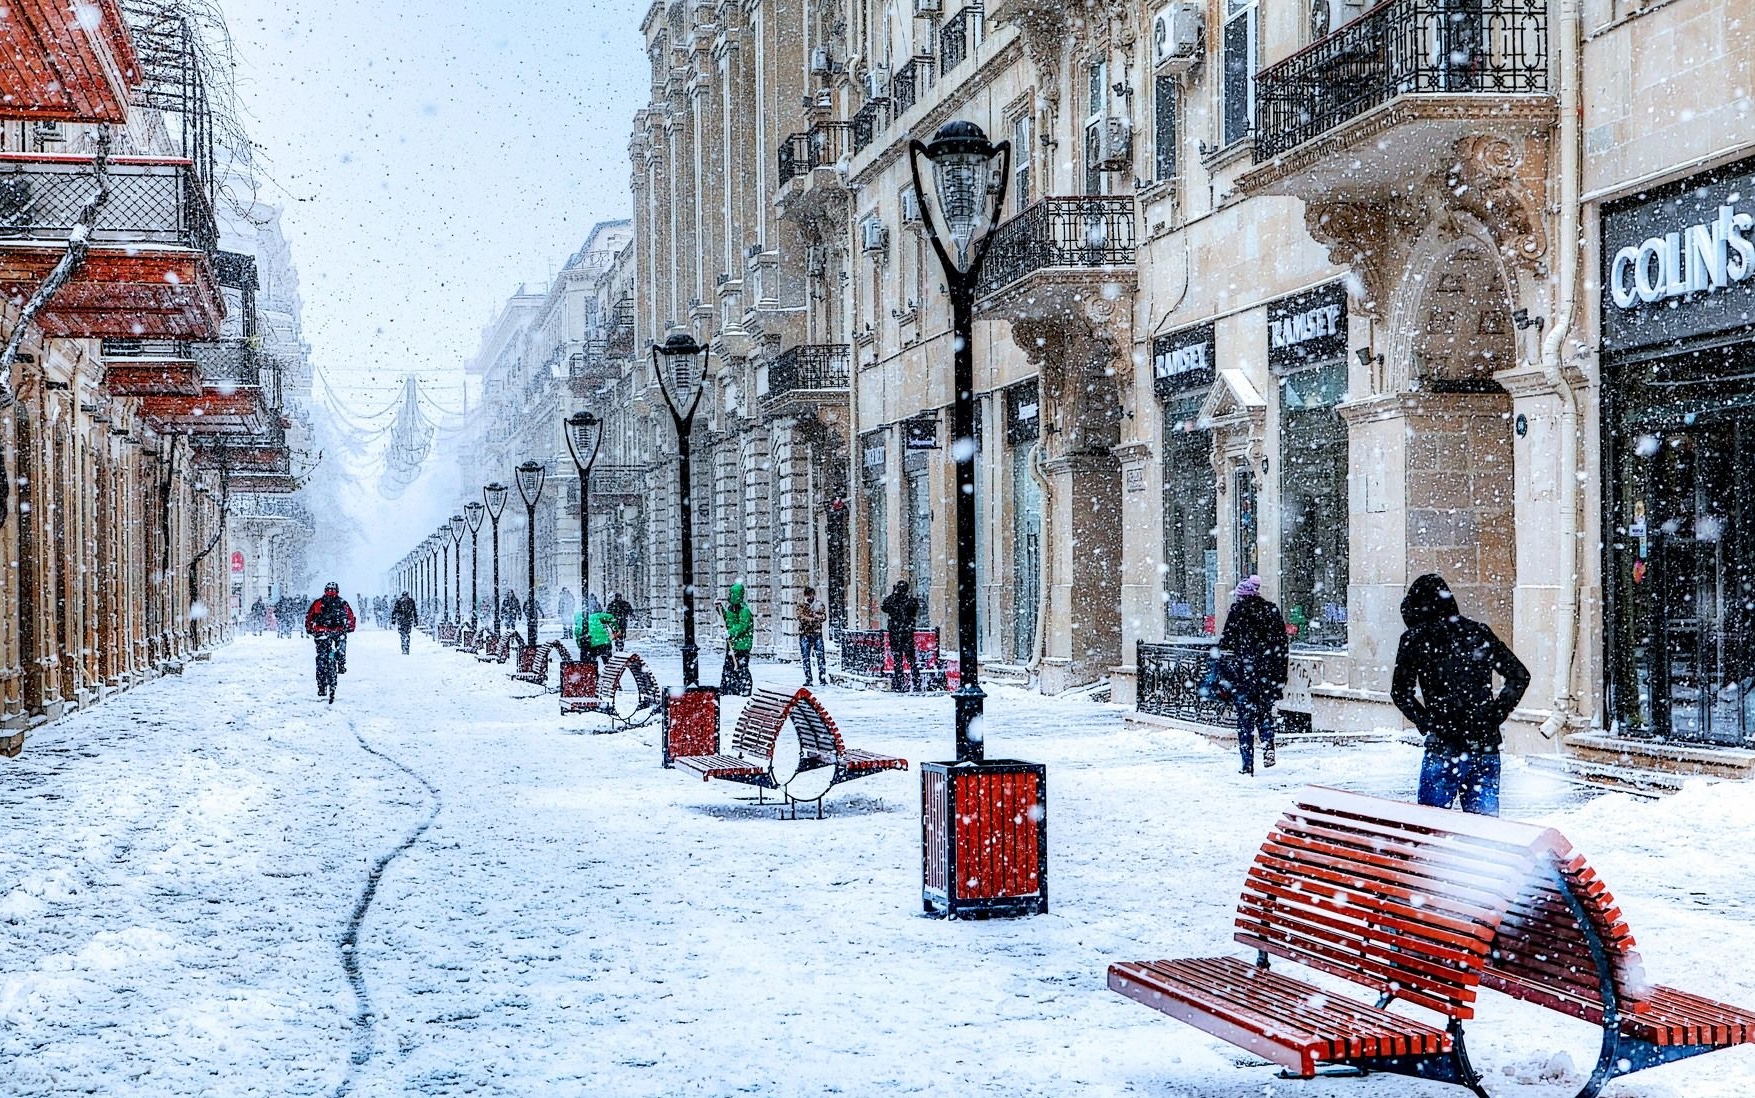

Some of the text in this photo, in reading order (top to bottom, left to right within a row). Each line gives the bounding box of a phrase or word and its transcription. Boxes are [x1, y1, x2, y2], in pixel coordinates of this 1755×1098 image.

[1610, 205, 1755, 309] COLIN'S
[1271, 303, 1341, 349] RAMSEY
[1155, 340, 1208, 379] RAMSEY
